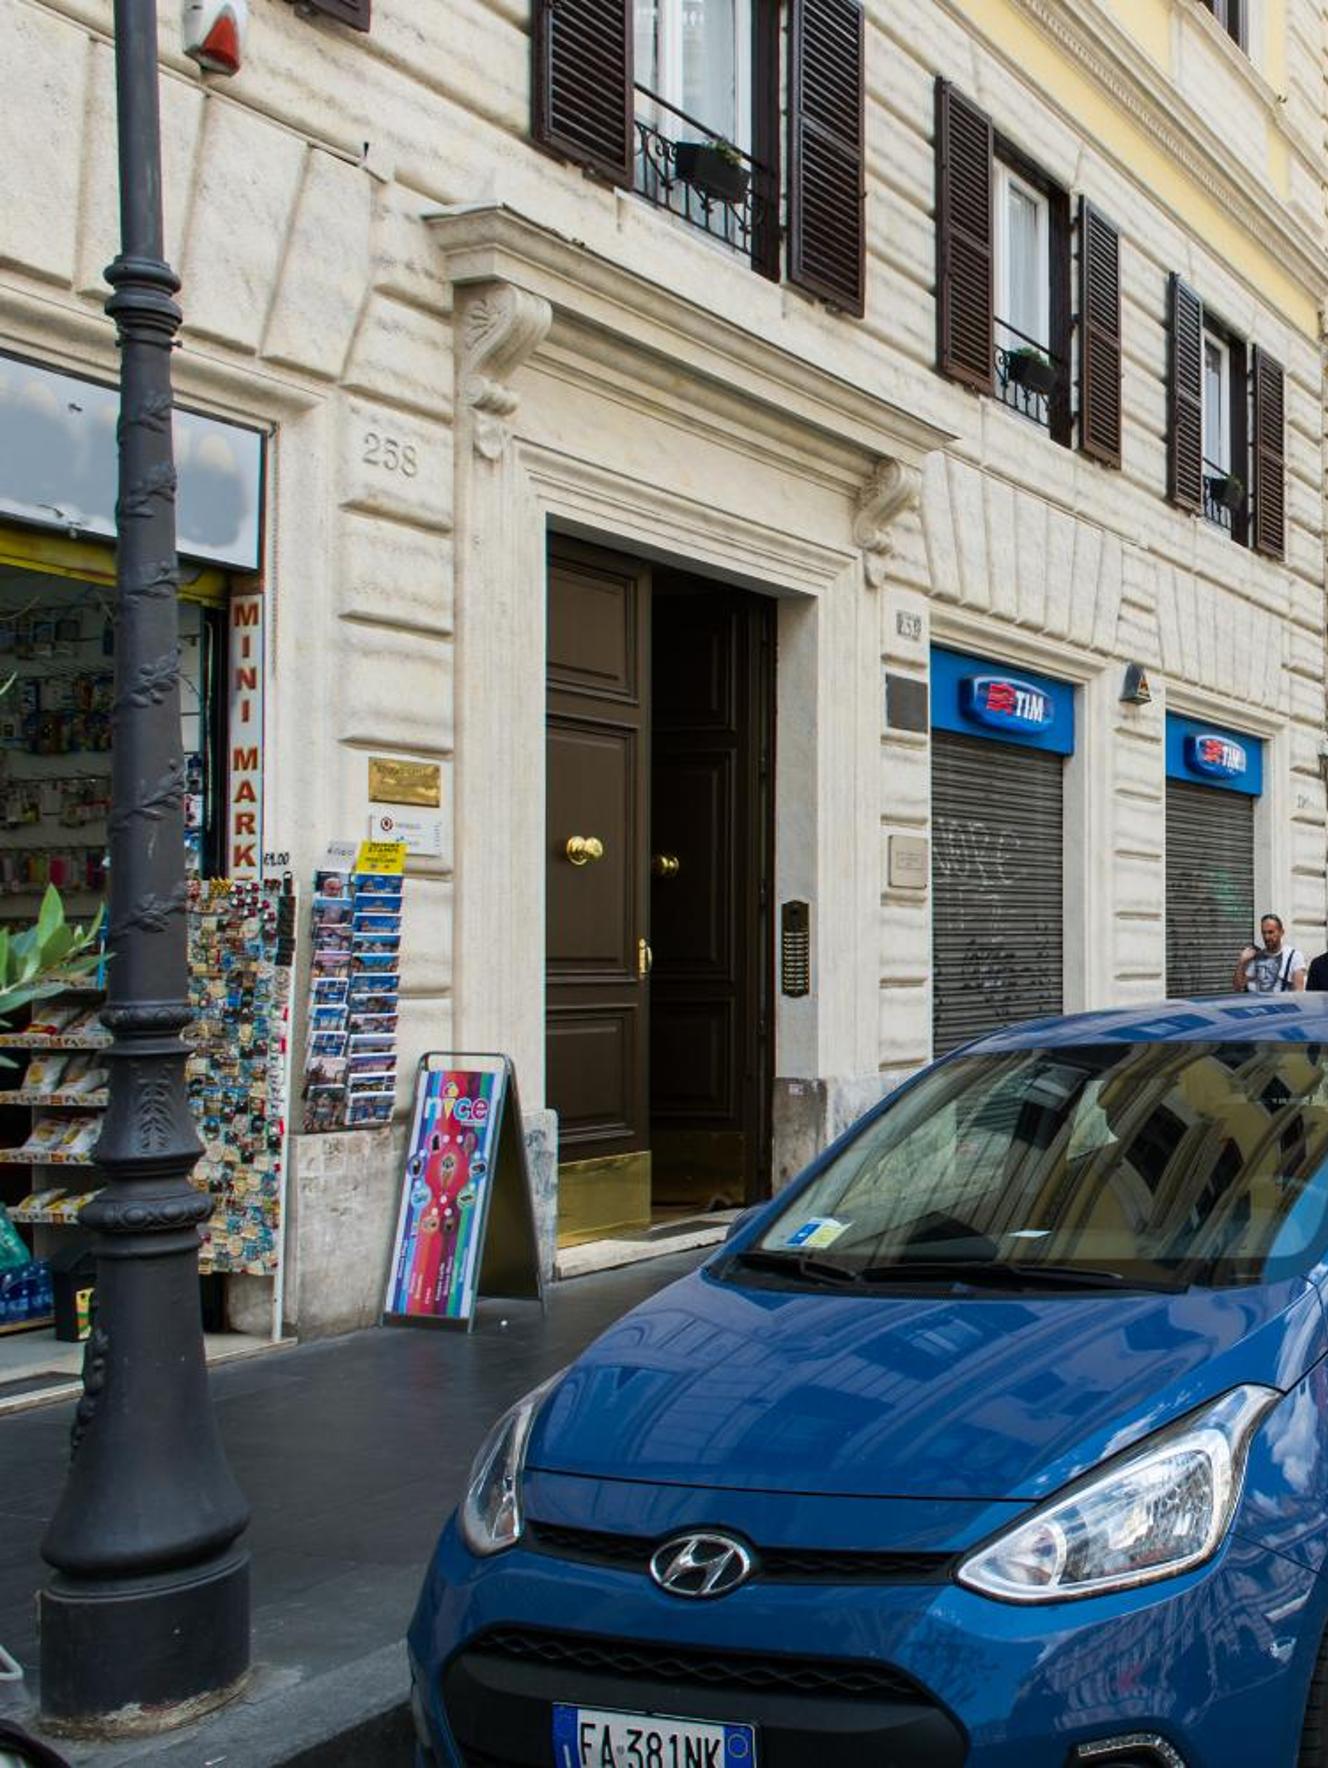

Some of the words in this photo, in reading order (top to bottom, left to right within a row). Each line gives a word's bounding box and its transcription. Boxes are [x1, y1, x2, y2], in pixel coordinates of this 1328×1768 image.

[362, 431, 417, 478] 258
[233, 603, 259, 722] MINI
[1016, 690, 1044, 722] TIM
[1222, 745, 1241, 772] TIM
[231, 746, 259, 881] MARK
